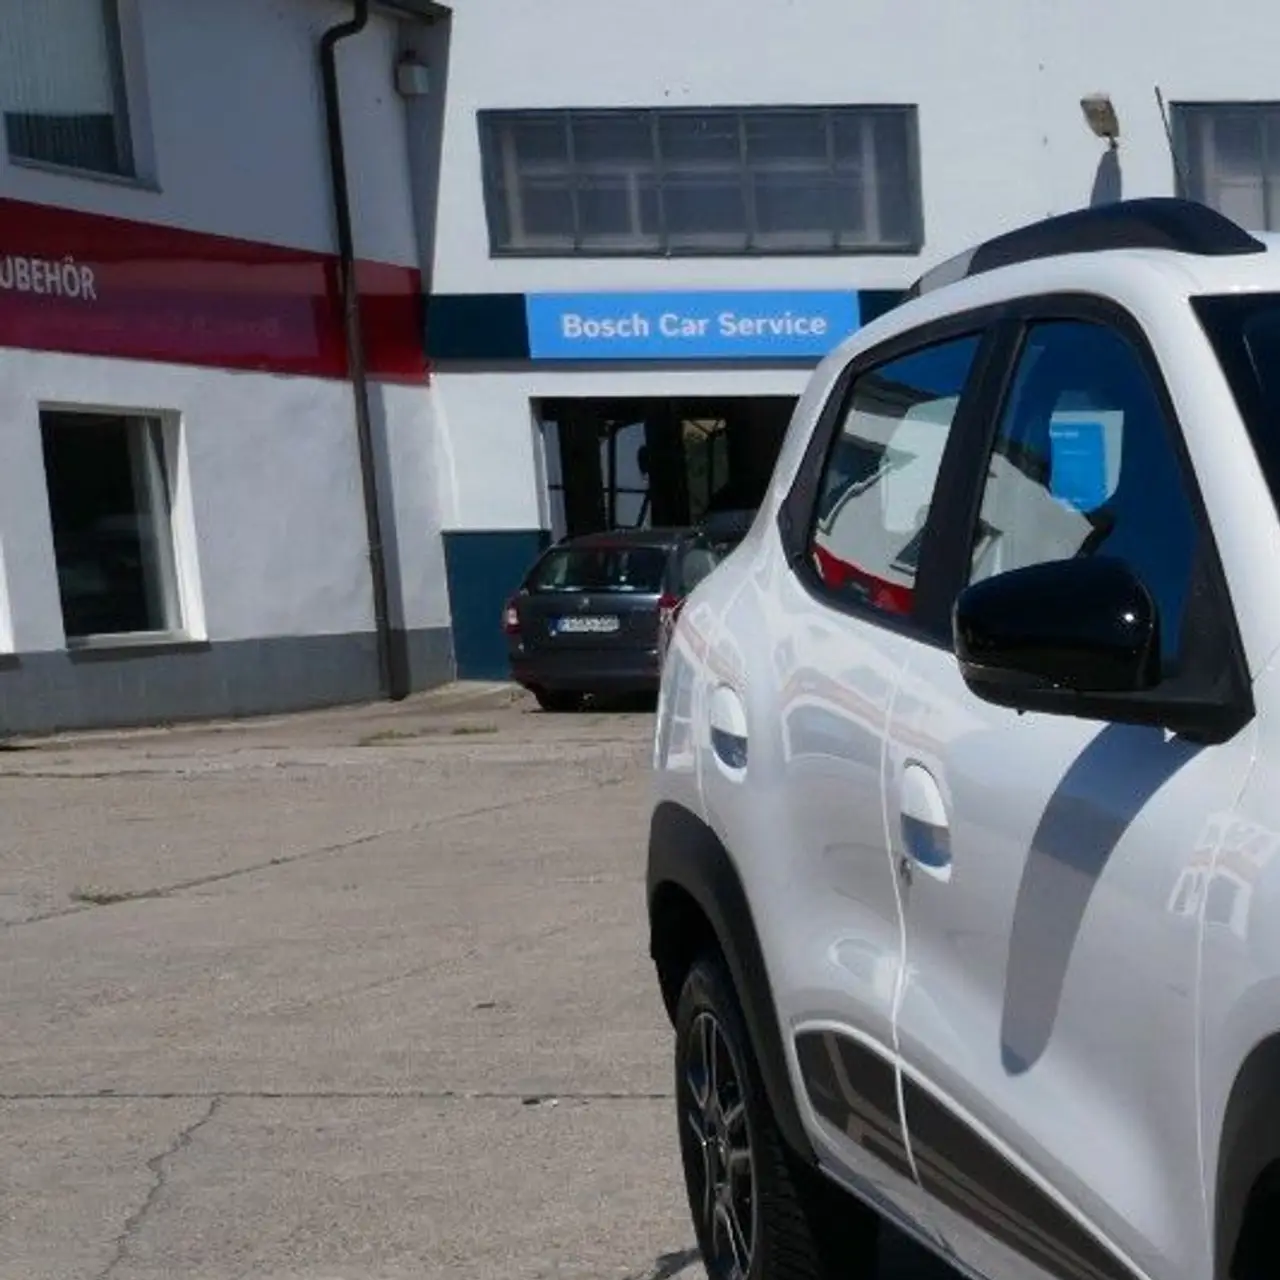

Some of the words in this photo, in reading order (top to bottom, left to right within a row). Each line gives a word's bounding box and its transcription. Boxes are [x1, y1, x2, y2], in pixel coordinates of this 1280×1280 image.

[561, 312, 649, 337] Bosch
[659, 313, 710, 337] Car
[719, 311, 827, 337] Service
